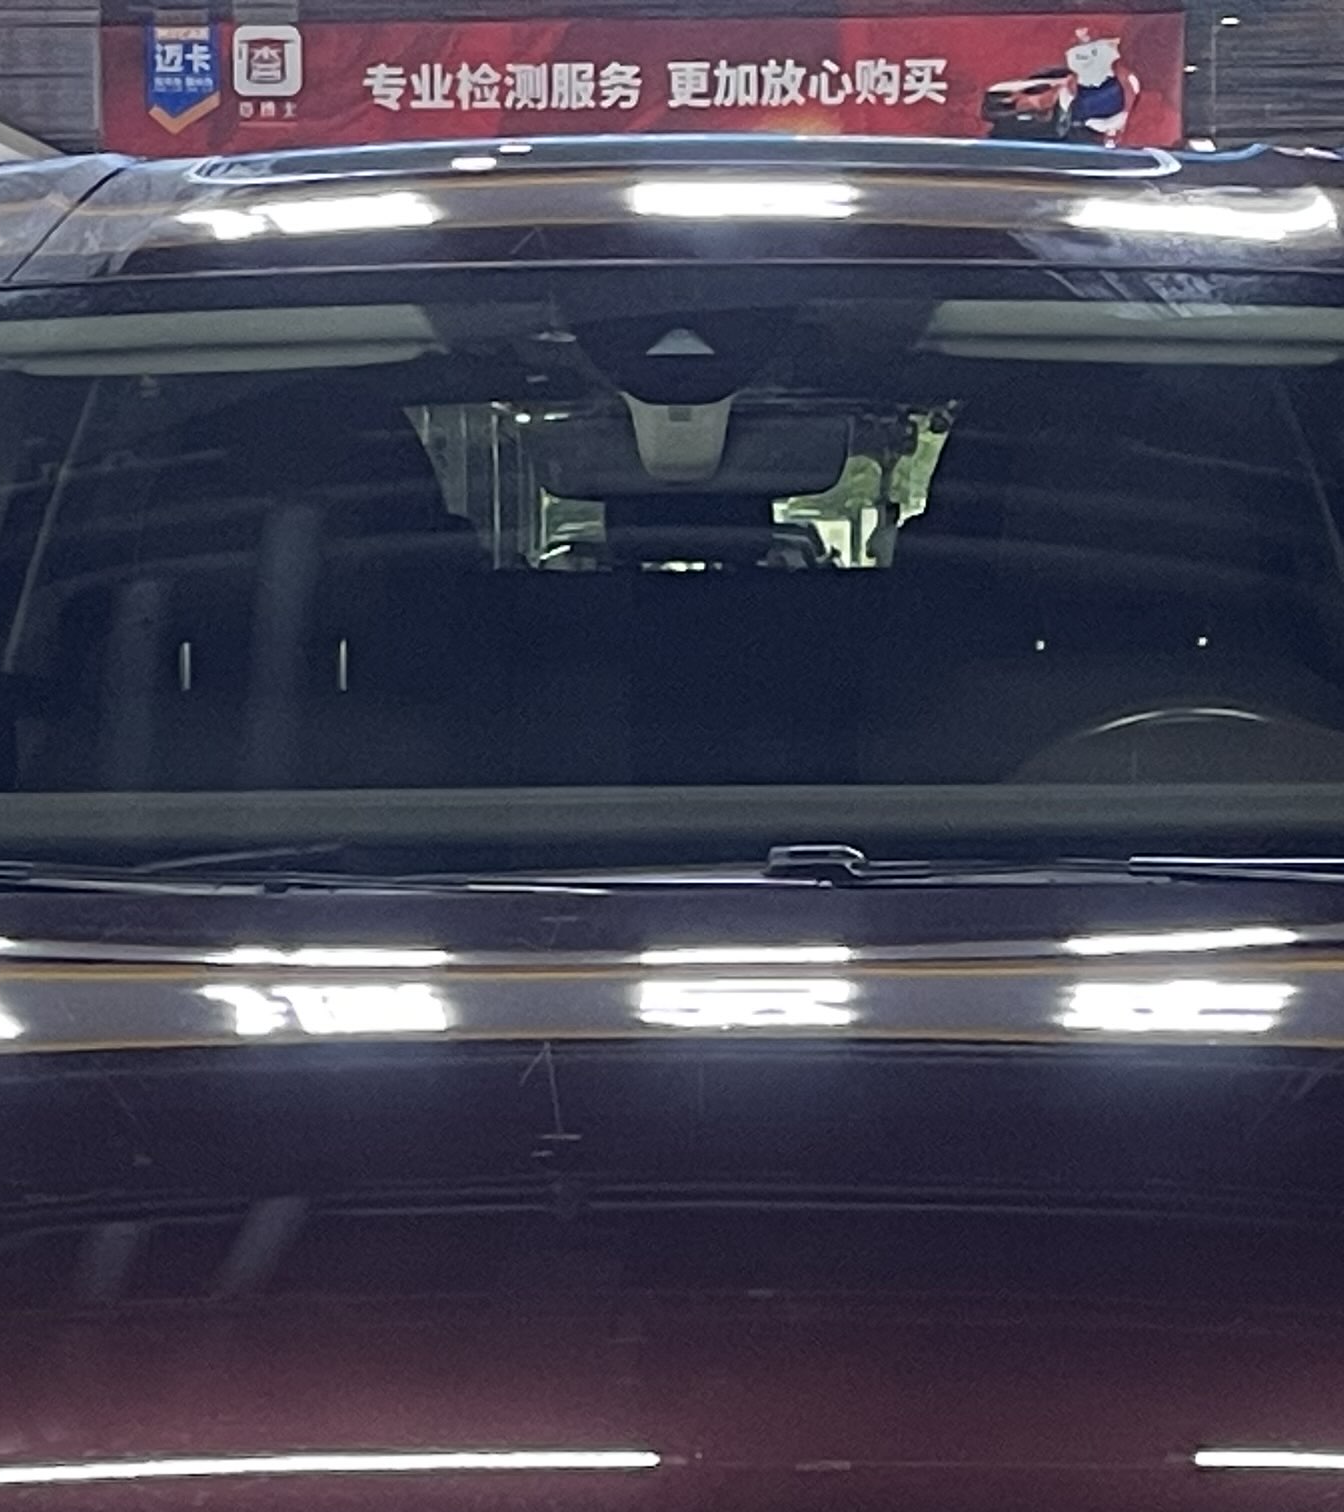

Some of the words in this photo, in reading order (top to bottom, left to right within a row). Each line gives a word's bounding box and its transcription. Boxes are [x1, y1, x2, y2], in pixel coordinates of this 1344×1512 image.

[155, 44, 211, 72] 迈卡
[362, 62, 643, 110] 专业检测服务
[667, 58, 949, 108] 更加放心购买
